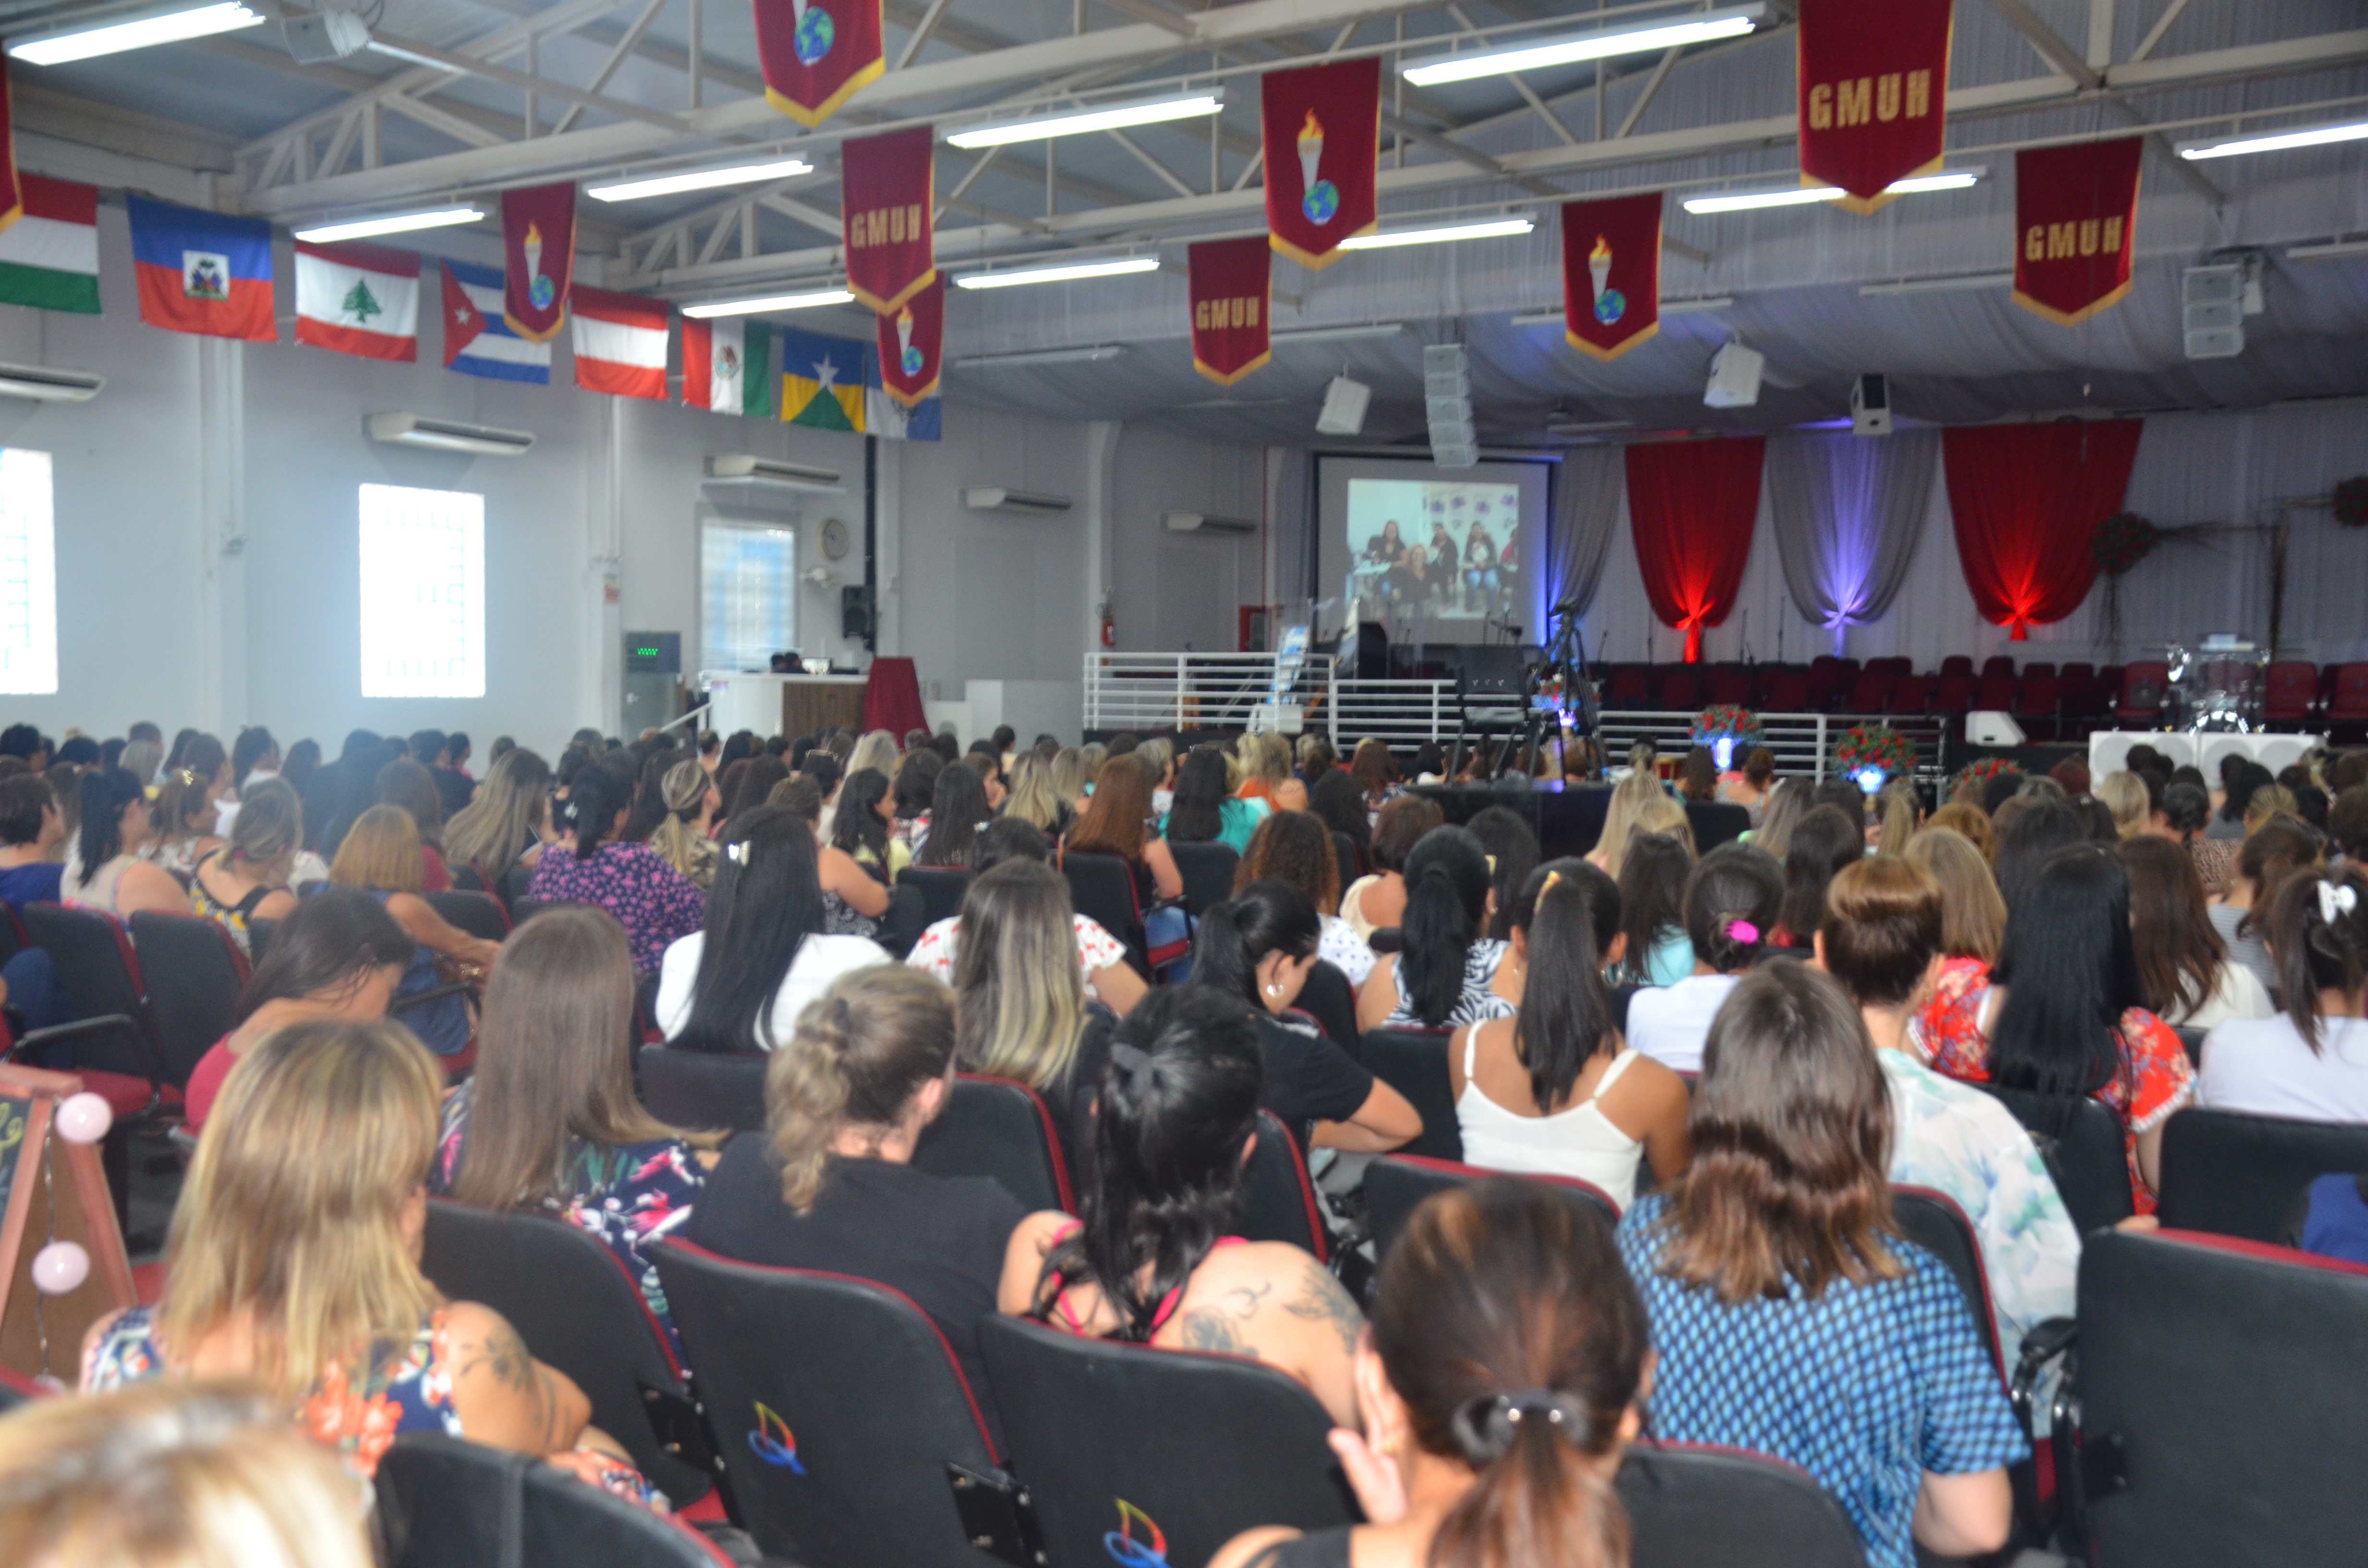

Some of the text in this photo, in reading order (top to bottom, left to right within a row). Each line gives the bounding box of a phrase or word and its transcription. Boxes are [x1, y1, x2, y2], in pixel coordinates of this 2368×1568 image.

[1809, 68, 1931, 130] GMUH
[851, 203, 922, 250] GMUH
[2025, 214, 2124, 262] GMUH
[1196, 296, 1260, 331] GMUH
